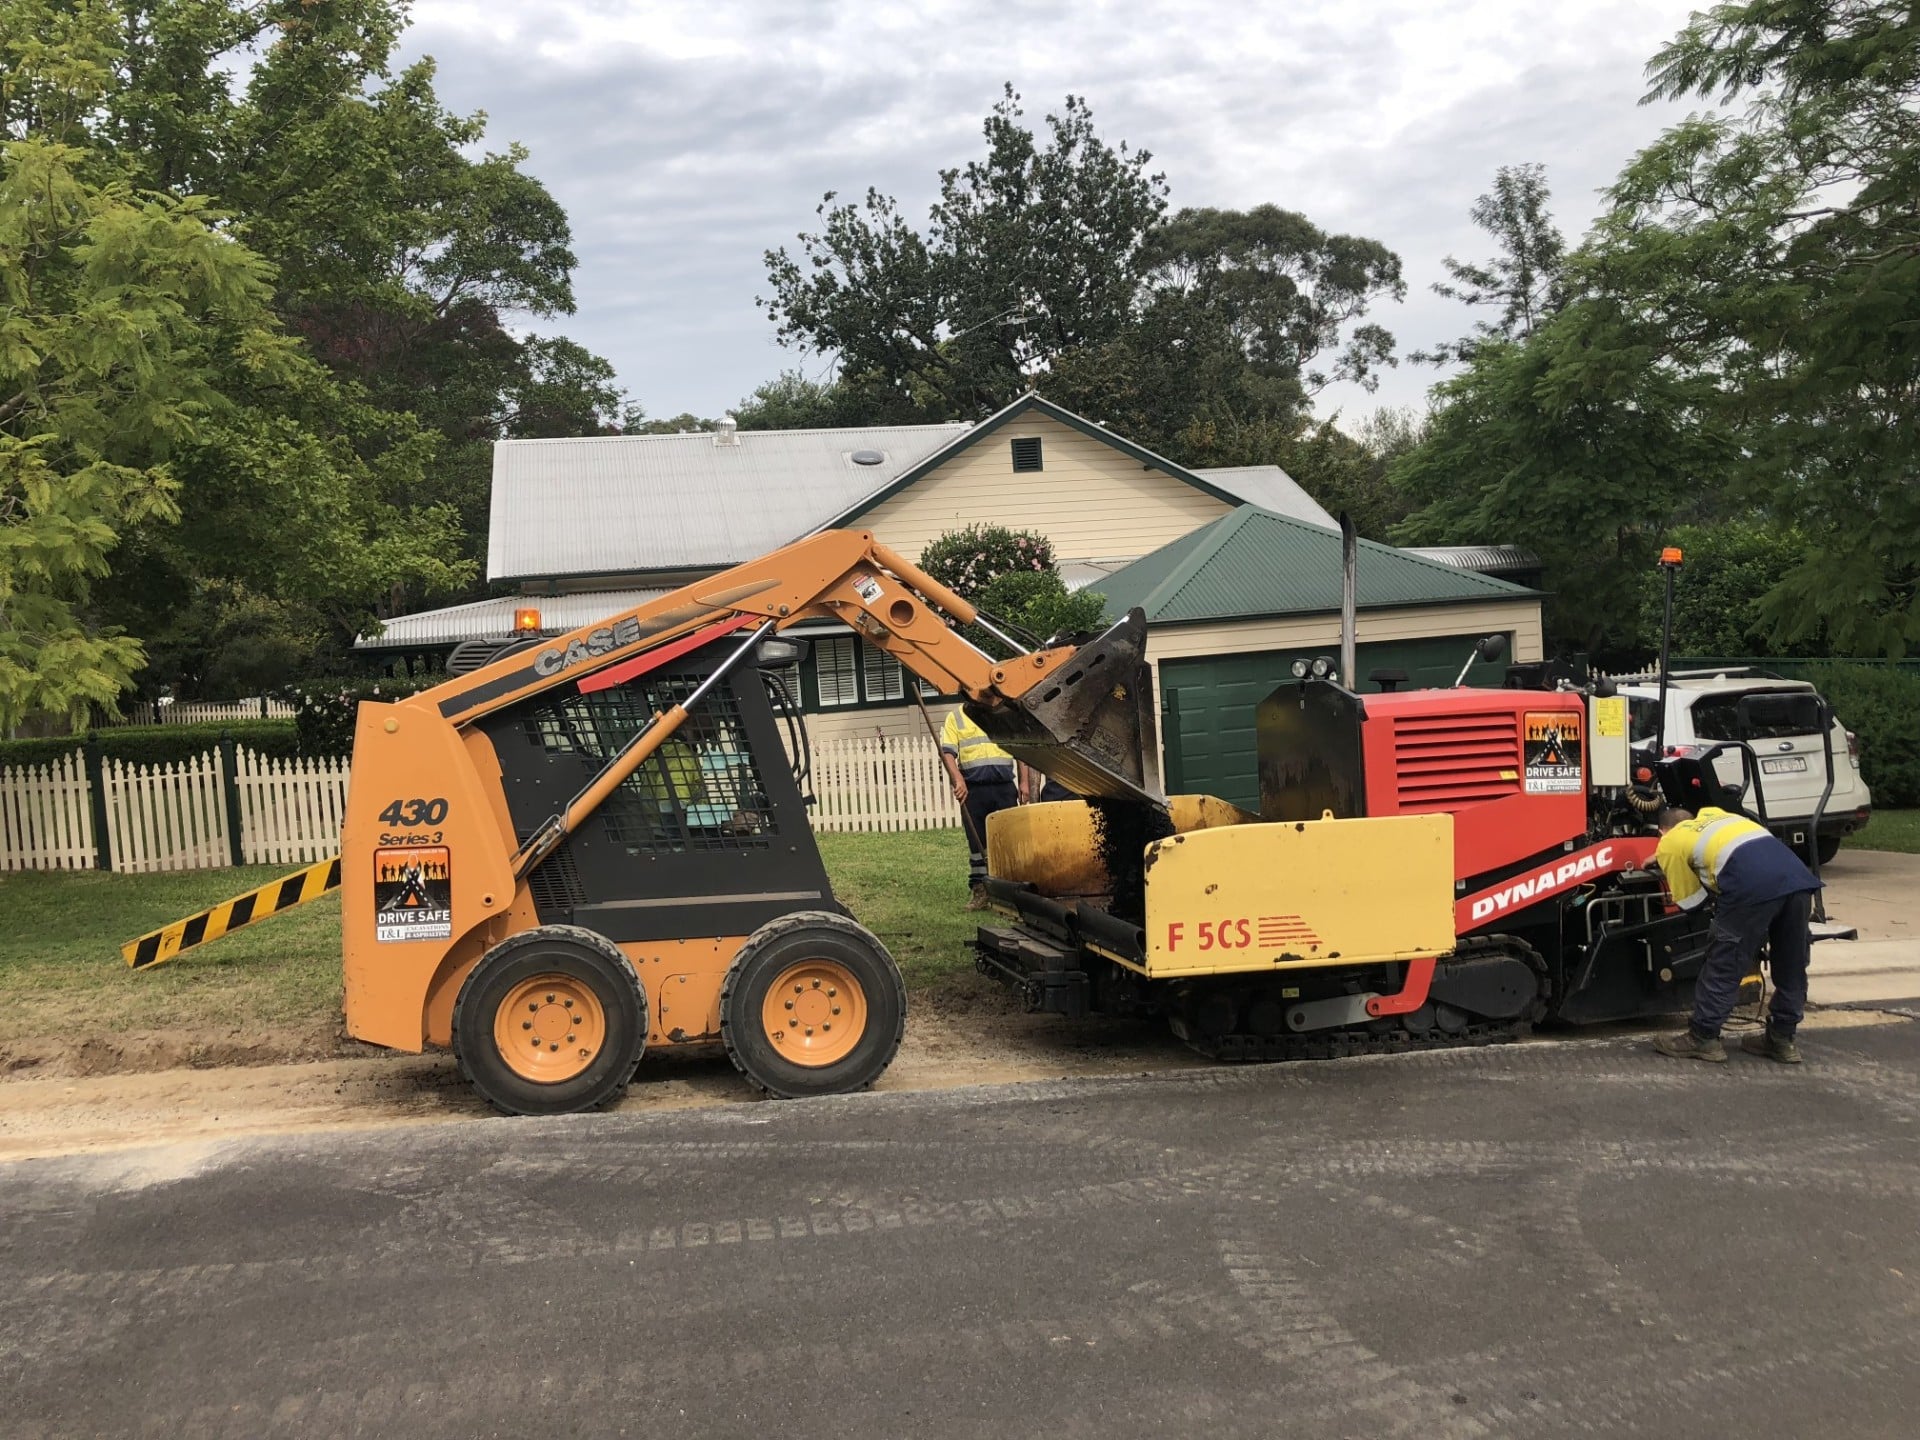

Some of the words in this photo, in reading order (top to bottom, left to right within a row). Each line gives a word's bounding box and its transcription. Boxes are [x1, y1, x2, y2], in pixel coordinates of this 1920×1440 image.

[534, 614, 641, 676] CASE
[1526, 767, 1555, 777] DRIVE
[1556, 767, 1581, 777] SAFE
[378, 798, 449, 827] 430
[378, 832, 430, 846] Series
[432, 831, 443, 844] 3
[1472, 846, 1613, 921] DYNAPAC
[378, 912, 416, 924] DRIVE
[418, 910, 450, 922] SAFE
[1168, 922, 1184, 952] F
[1198, 918, 1251, 950] 5CS
